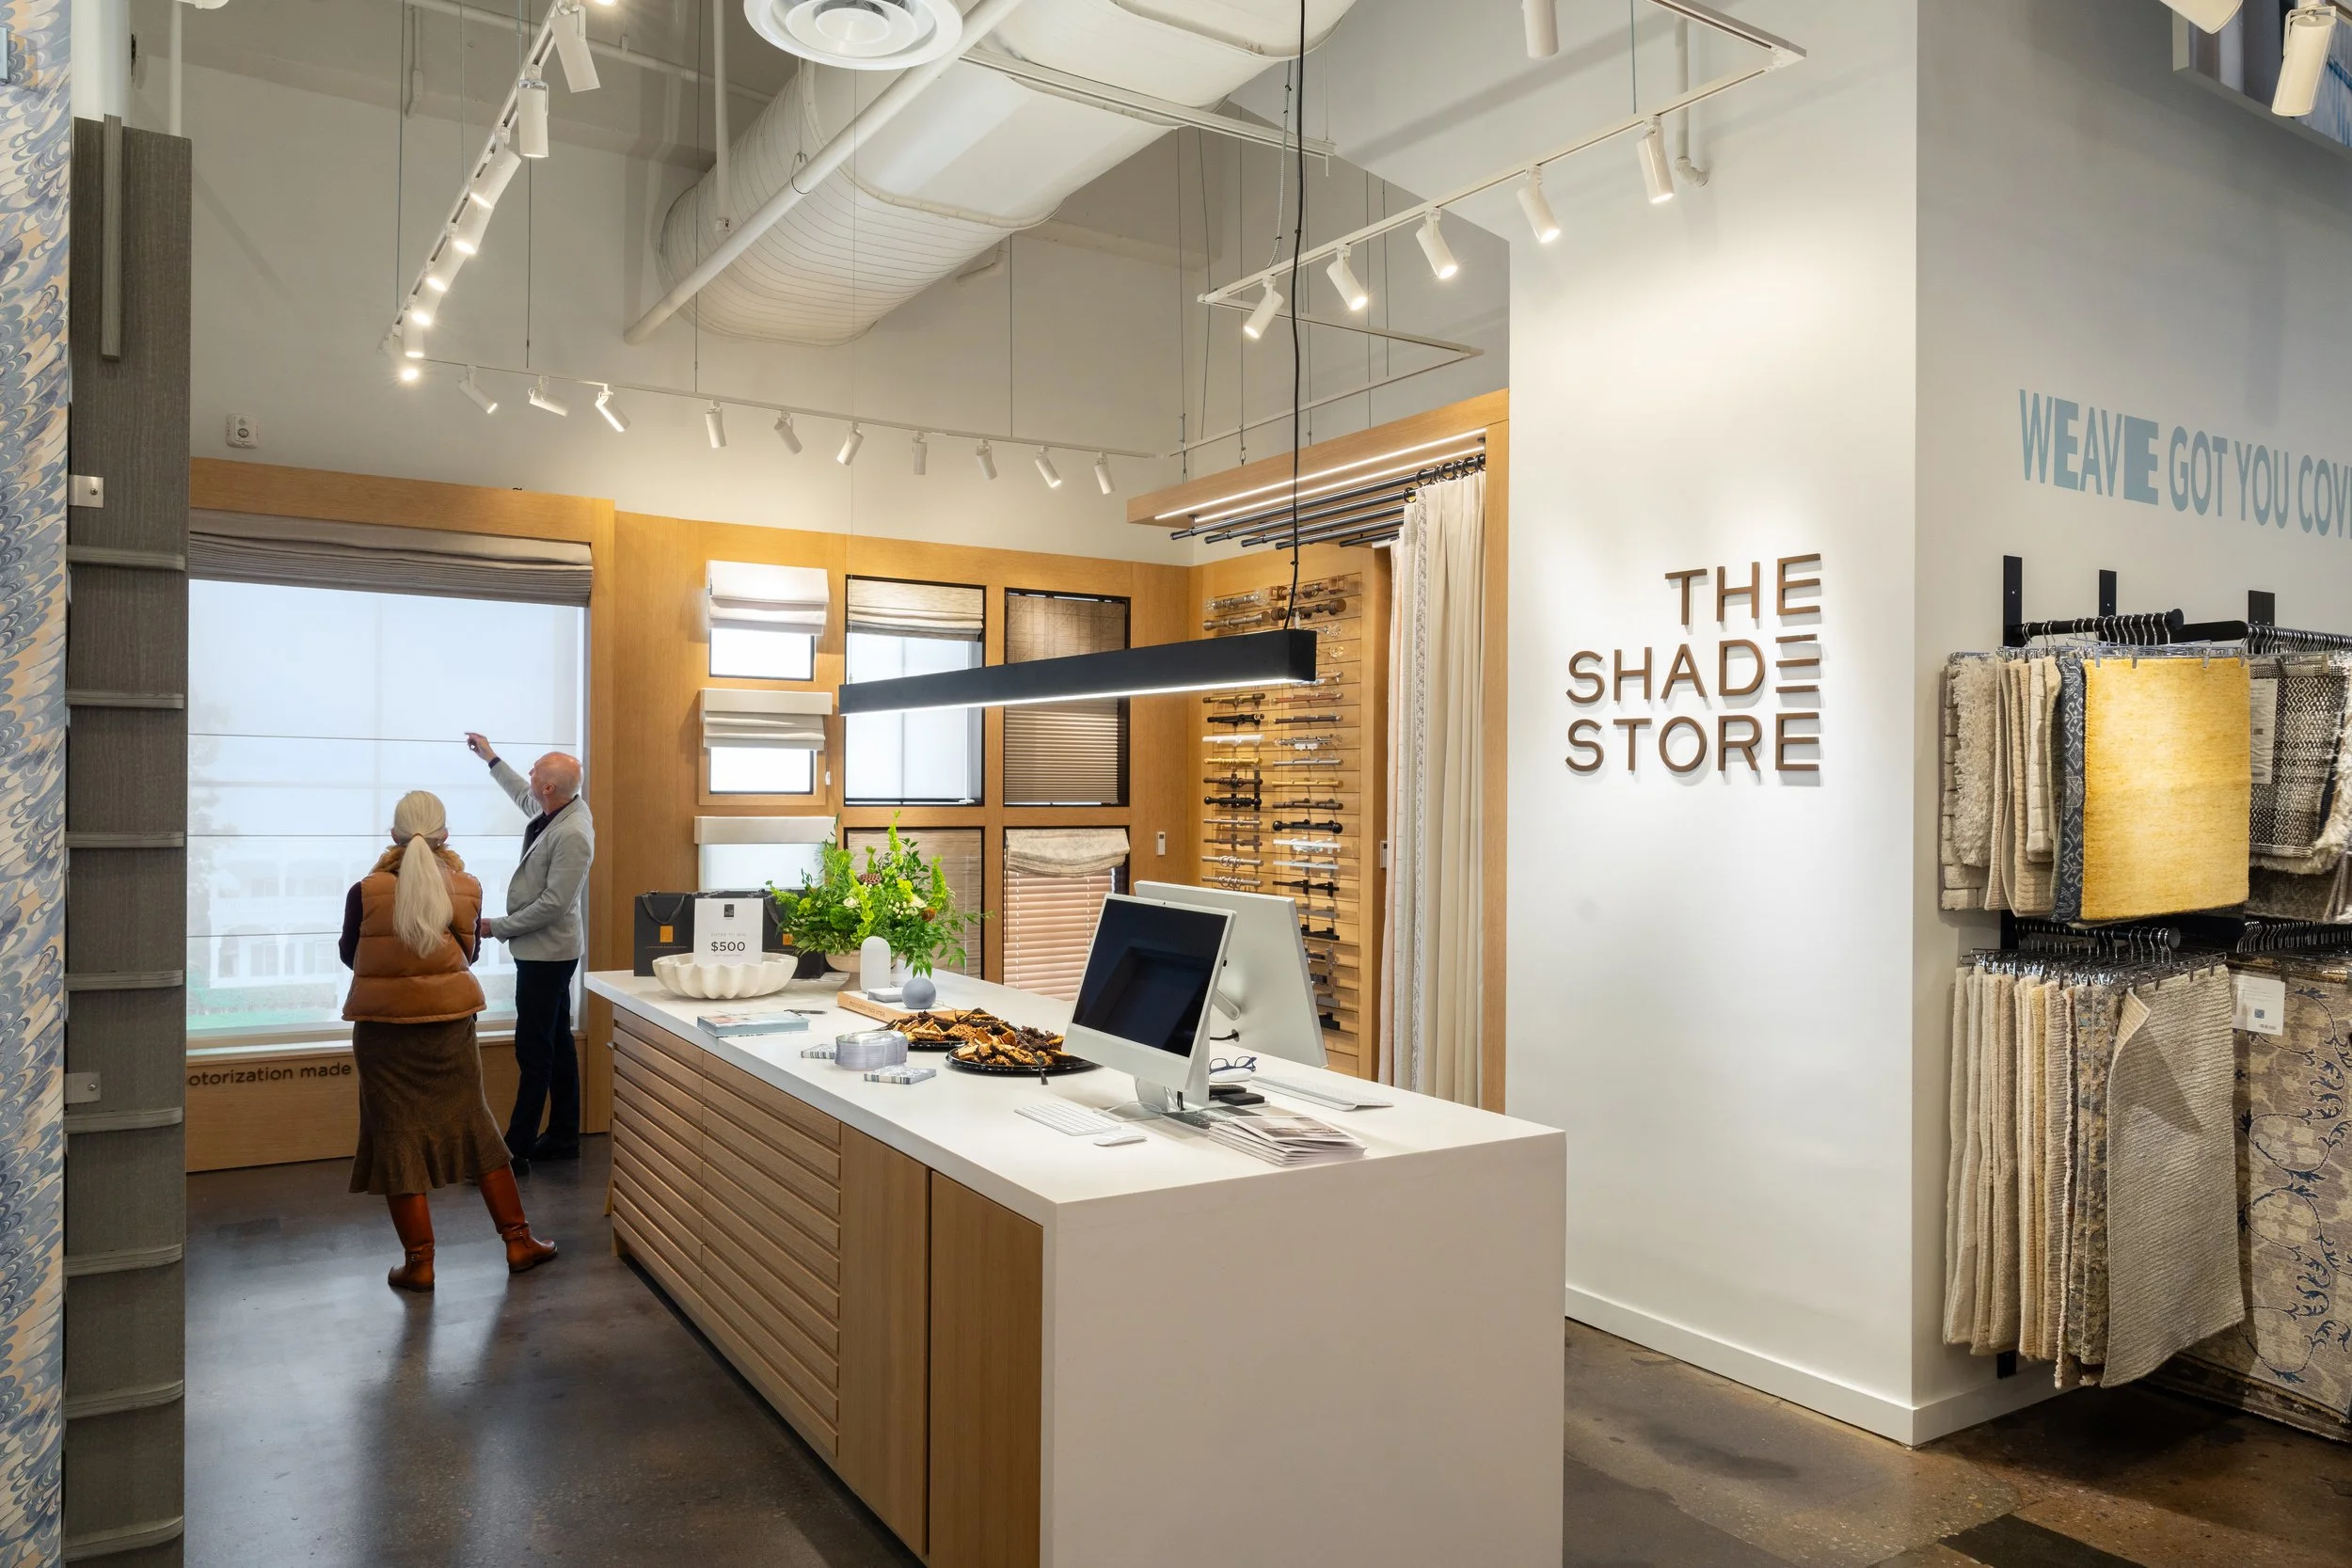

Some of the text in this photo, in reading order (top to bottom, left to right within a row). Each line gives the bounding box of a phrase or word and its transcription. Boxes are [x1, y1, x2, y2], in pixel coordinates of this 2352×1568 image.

[2019, 388, 2352, 540] WEAVE GOT YOU COV
[1664, 553, 1821, 626] THE
[1565, 633, 1821, 704] SHADE
[1565, 713, 1820, 772] STORE
[710, 941, 746, 953] $500
[186, 1062, 352, 1086] otorization made
